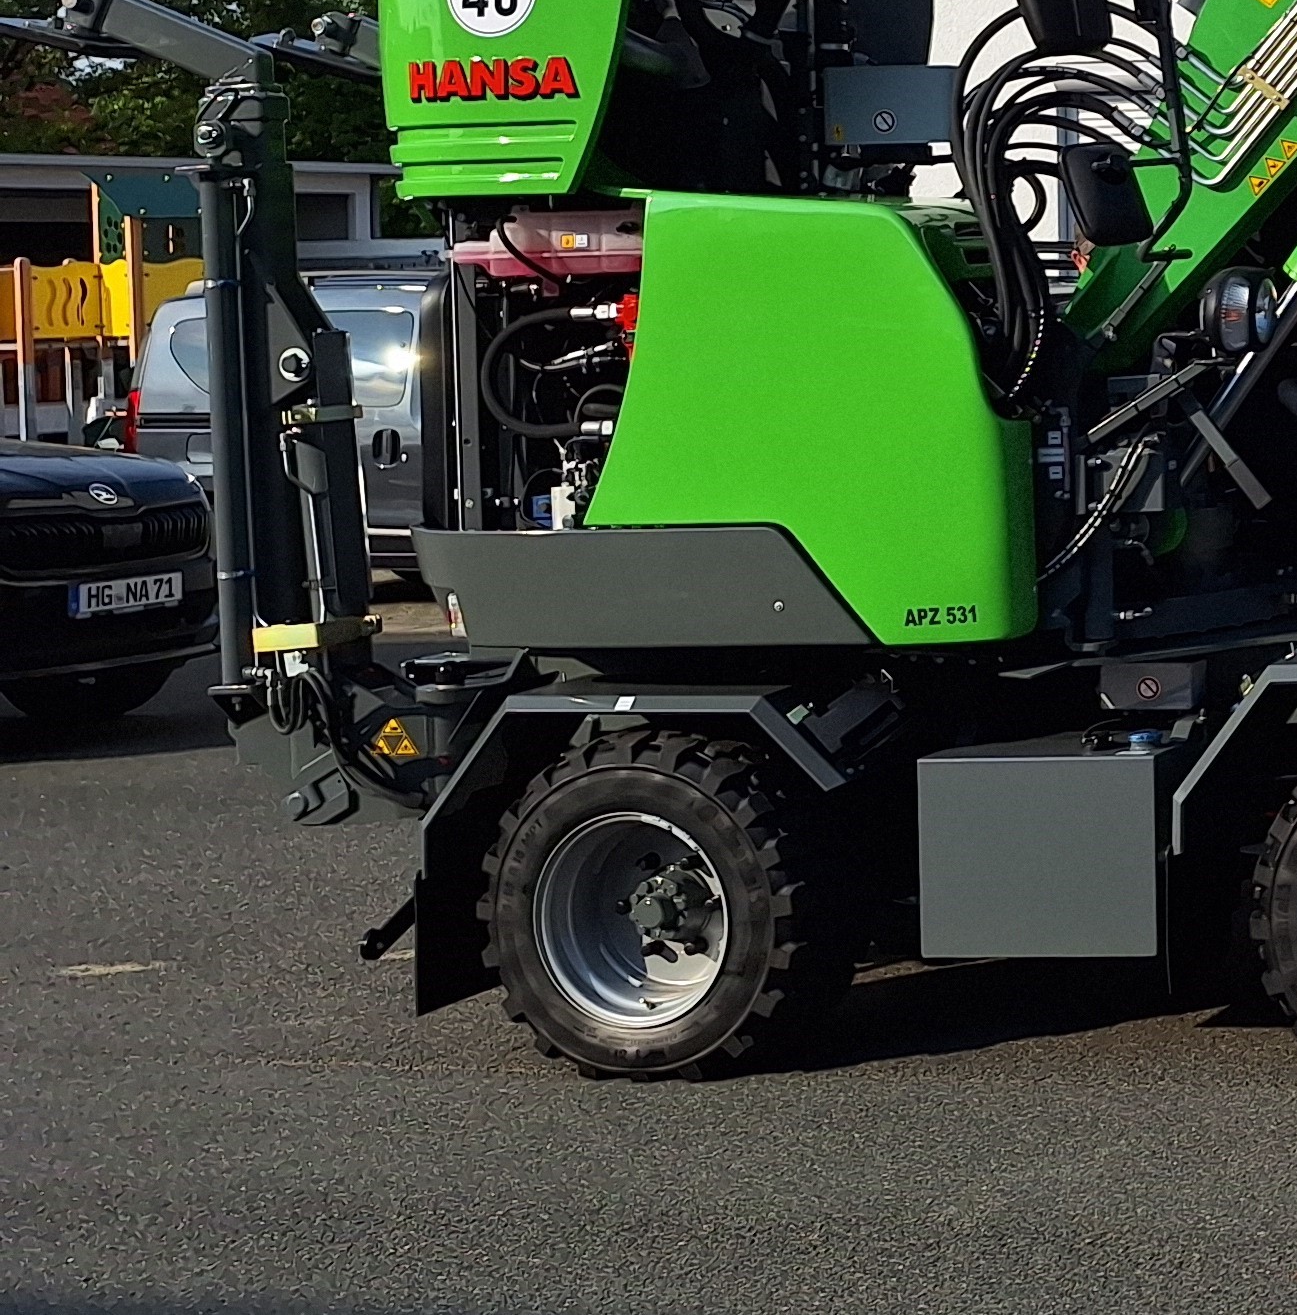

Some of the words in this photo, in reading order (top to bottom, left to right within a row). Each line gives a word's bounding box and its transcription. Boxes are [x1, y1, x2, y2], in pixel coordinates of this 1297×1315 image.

[409, 56, 581, 103] HANSA
[87, 585, 113, 609] HG
[905, 608, 941, 626] APZ
[946, 605, 977, 624] 531
